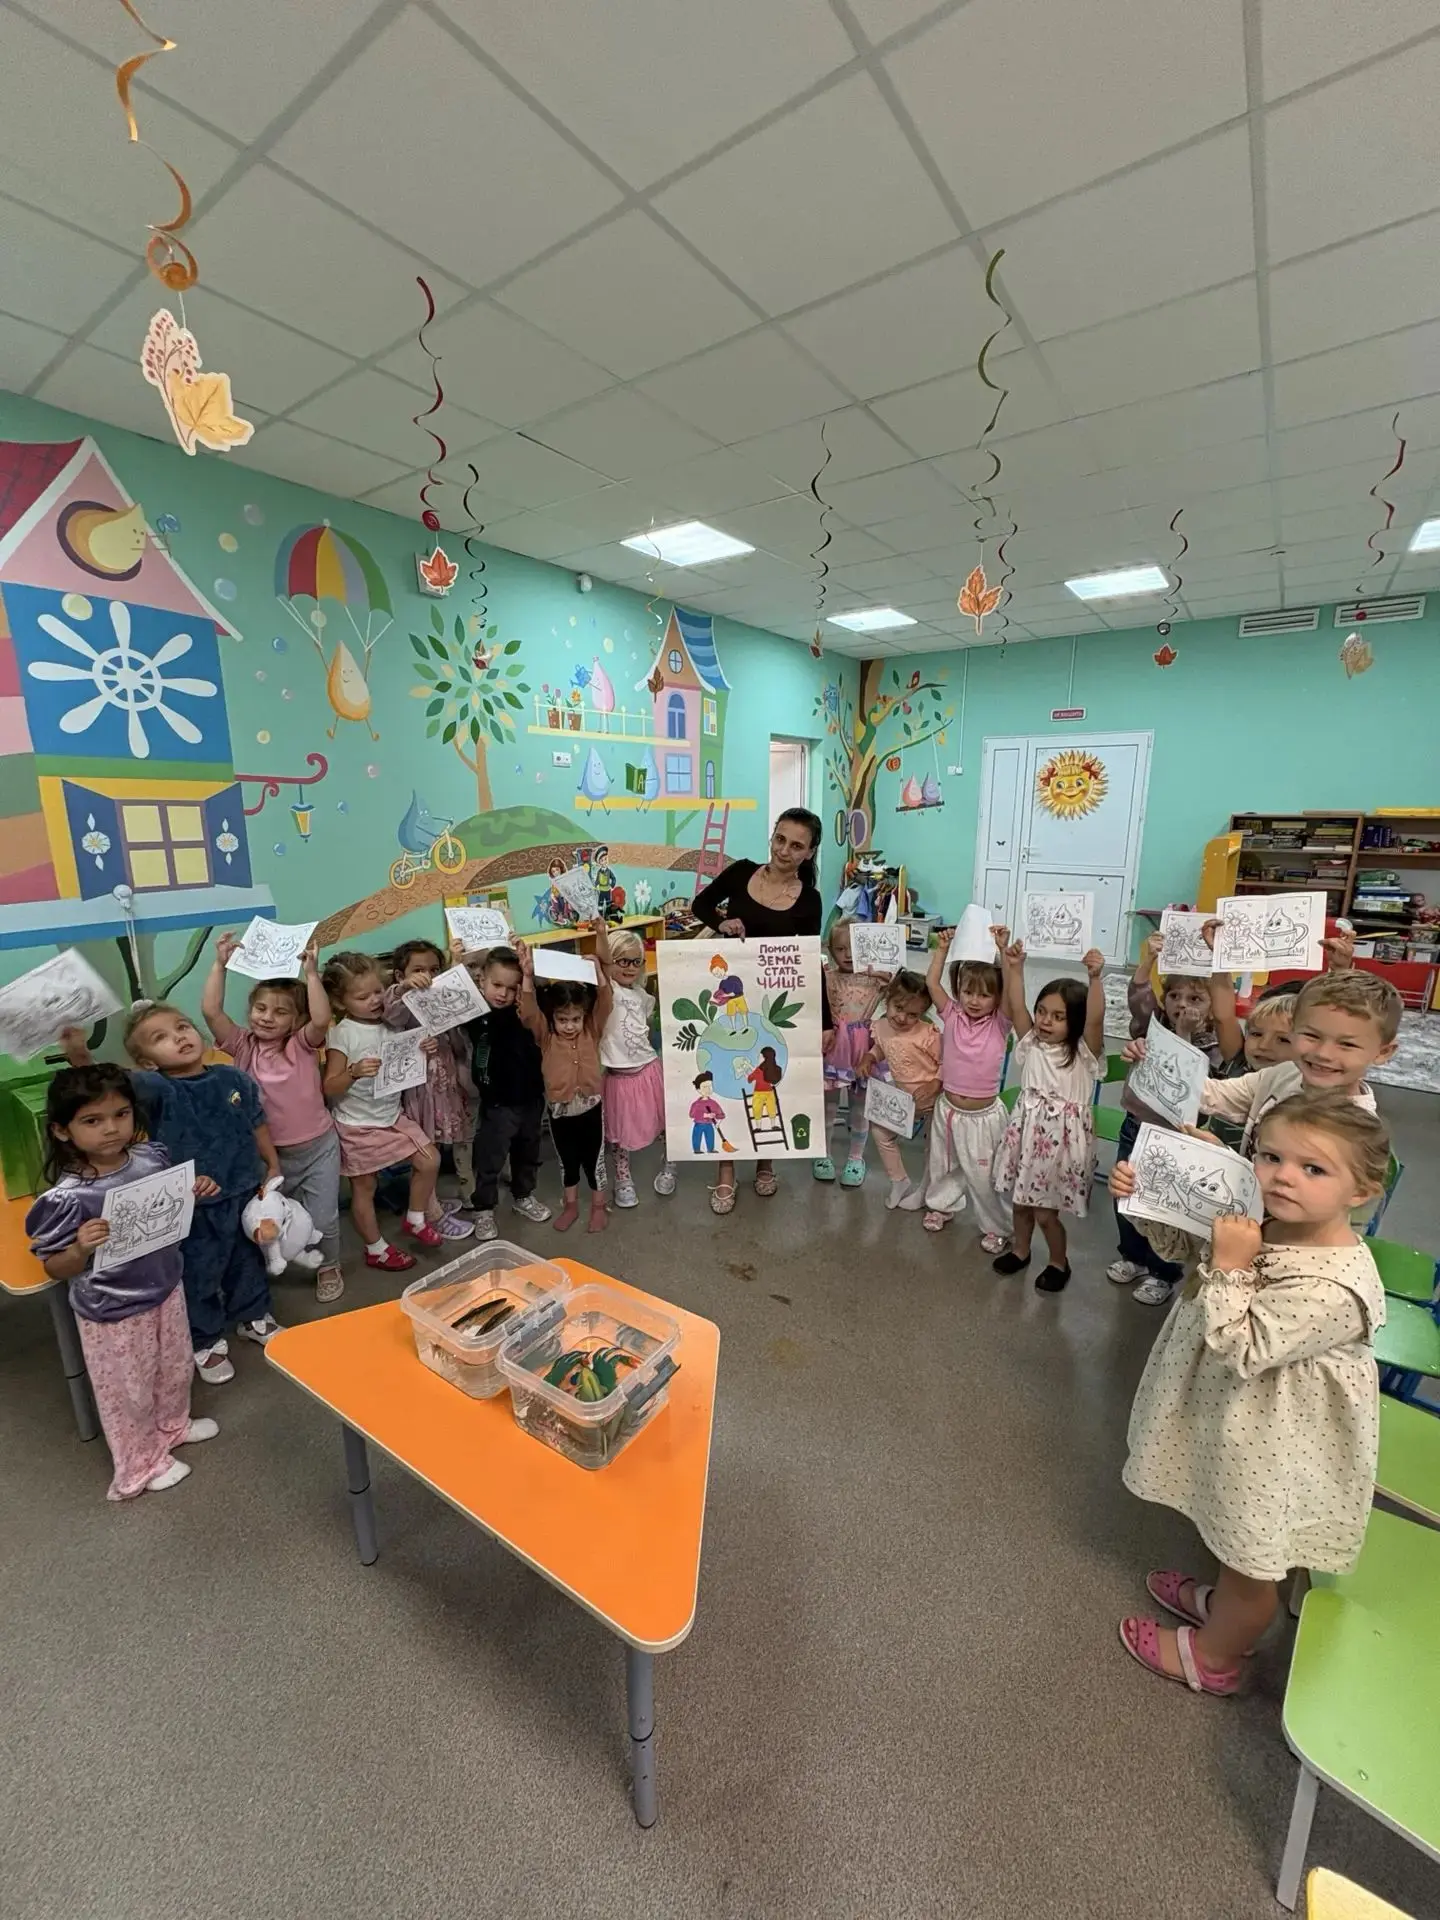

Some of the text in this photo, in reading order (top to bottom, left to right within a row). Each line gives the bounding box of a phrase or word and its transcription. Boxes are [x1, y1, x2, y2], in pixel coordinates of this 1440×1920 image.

[758, 955, 801, 966] ЗЕМЛЕ
[764, 966, 798, 976] СТАТЬ
[756, 975, 806, 991] ЧИЩЕ
